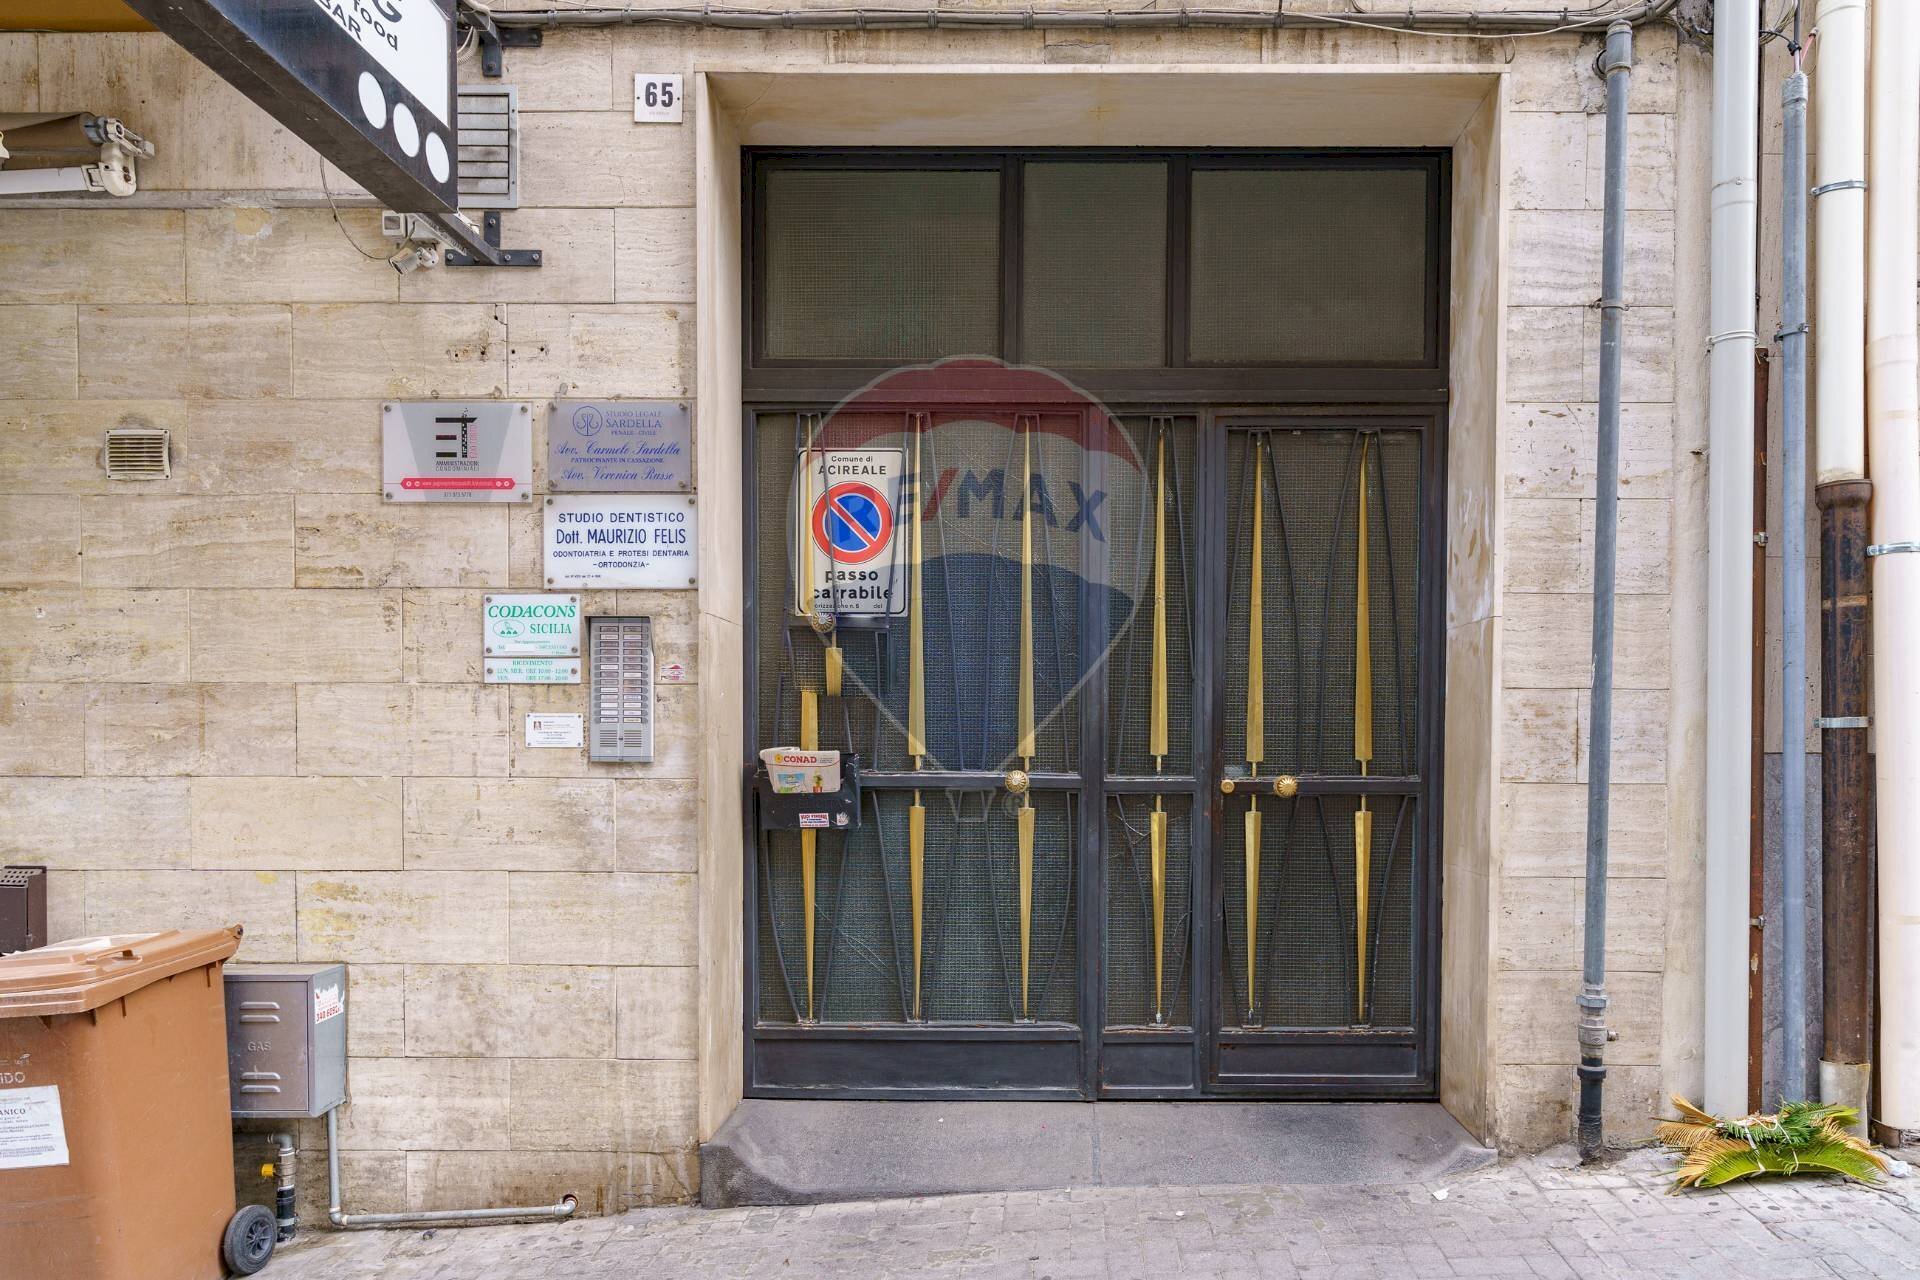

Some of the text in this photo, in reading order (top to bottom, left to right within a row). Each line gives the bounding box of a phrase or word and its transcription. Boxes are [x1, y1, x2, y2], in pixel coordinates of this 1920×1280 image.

[645, 81, 674, 107] 65
[605, 419, 662, 428] SARDELLA
[585, 440, 629, 455] Carmelo
[632, 440, 680, 456] Sardella
[592, 466, 638, 480] Veronica
[641, 466, 674, 480] Russo
[818, 465, 887, 475] ACIREALE
[558, 512, 685, 523] STUDIO DENTISTICO
[556, 528, 686, 544] Dott. MAURIZIO FELIS
[552, 550, 606, 558] ODONTOIATRIA
[652, 549, 689, 557] DENTARIA
[825, 570, 879, 583] passo
[813, 585, 893, 600] carabile
[488, 605, 576, 618] CODACONS
[529, 623, 572, 634] SICILIA
[783, 755, 817, 764] CONAD
[247, 1041, 272, 1052] GAS
